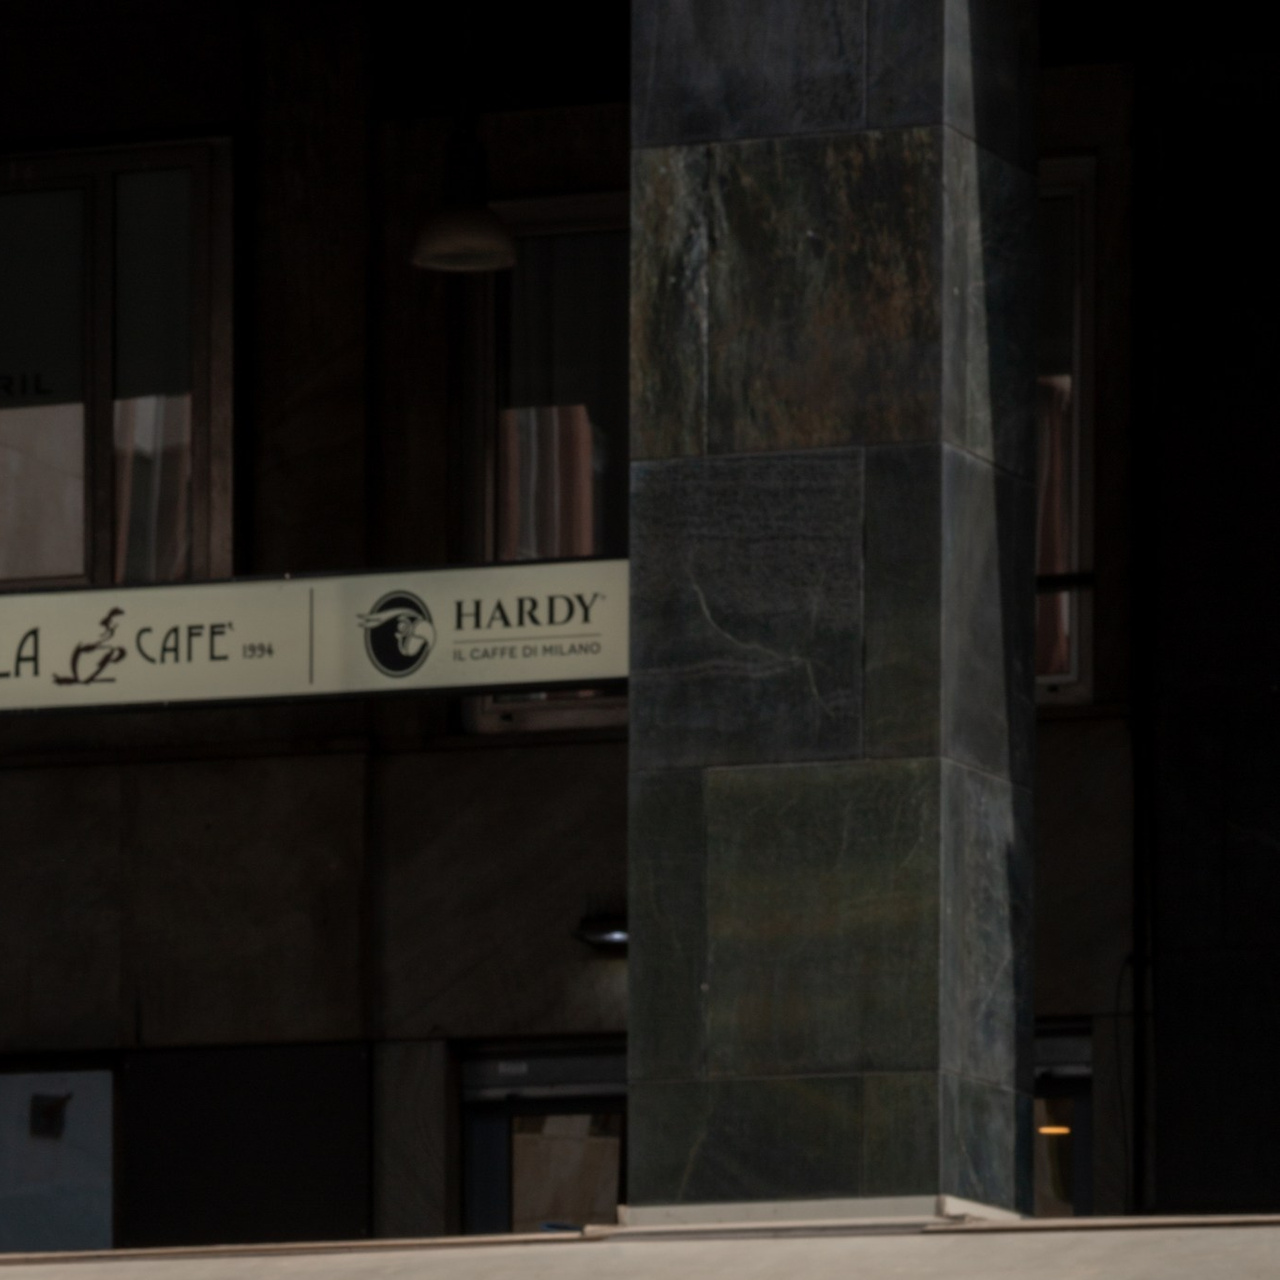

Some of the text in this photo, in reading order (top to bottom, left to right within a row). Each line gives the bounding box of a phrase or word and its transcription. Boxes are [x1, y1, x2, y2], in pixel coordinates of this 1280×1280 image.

[455, 592, 600, 630] HARDY
[453, 649, 466, 661] IL
[522, 644, 538, 658] DI
[543, 642, 601, 657] MILANO
